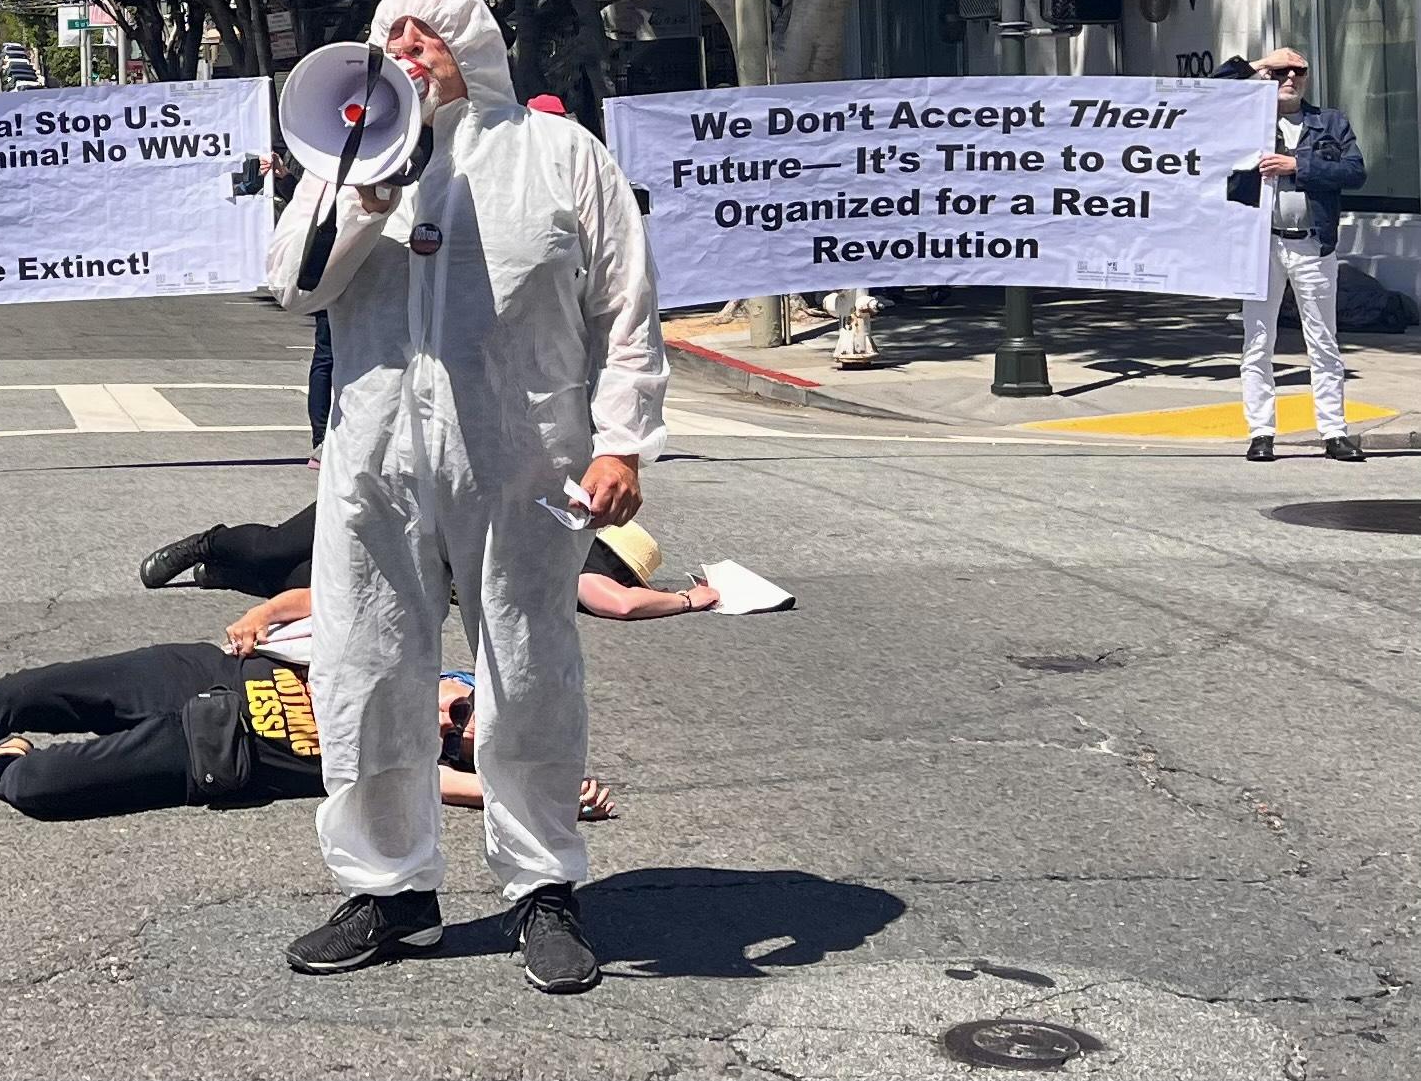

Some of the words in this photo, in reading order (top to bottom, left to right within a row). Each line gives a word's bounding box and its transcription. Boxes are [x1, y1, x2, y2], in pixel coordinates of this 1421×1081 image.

[36, 112, 111, 137] Stop
[125, 104, 190, 129] U.S.
[691, 112, 752, 141] We
[768, 103, 874, 135] Don’t
[889, 100, 1045, 134] Accept
[1070, 100, 1187, 129] Their
[83, 140, 126, 163] No
[138, 134, 230, 159] WW3!
[857, 146, 920, 174] It’s
[936, 144, 1044, 171] Time
[1061, 145, 1104, 172] to
[1122, 146, 1200, 175] Get
[715, 189, 920, 231] Organized
[935, 188, 996, 215] for
[1011, 195, 1034, 215] a
[1053, 188, 1149, 218] Real
[813, 231, 1038, 264] Revolution
[19, 252, 149, 280] Extinct!
[245, 680, 287, 738] LESS!
